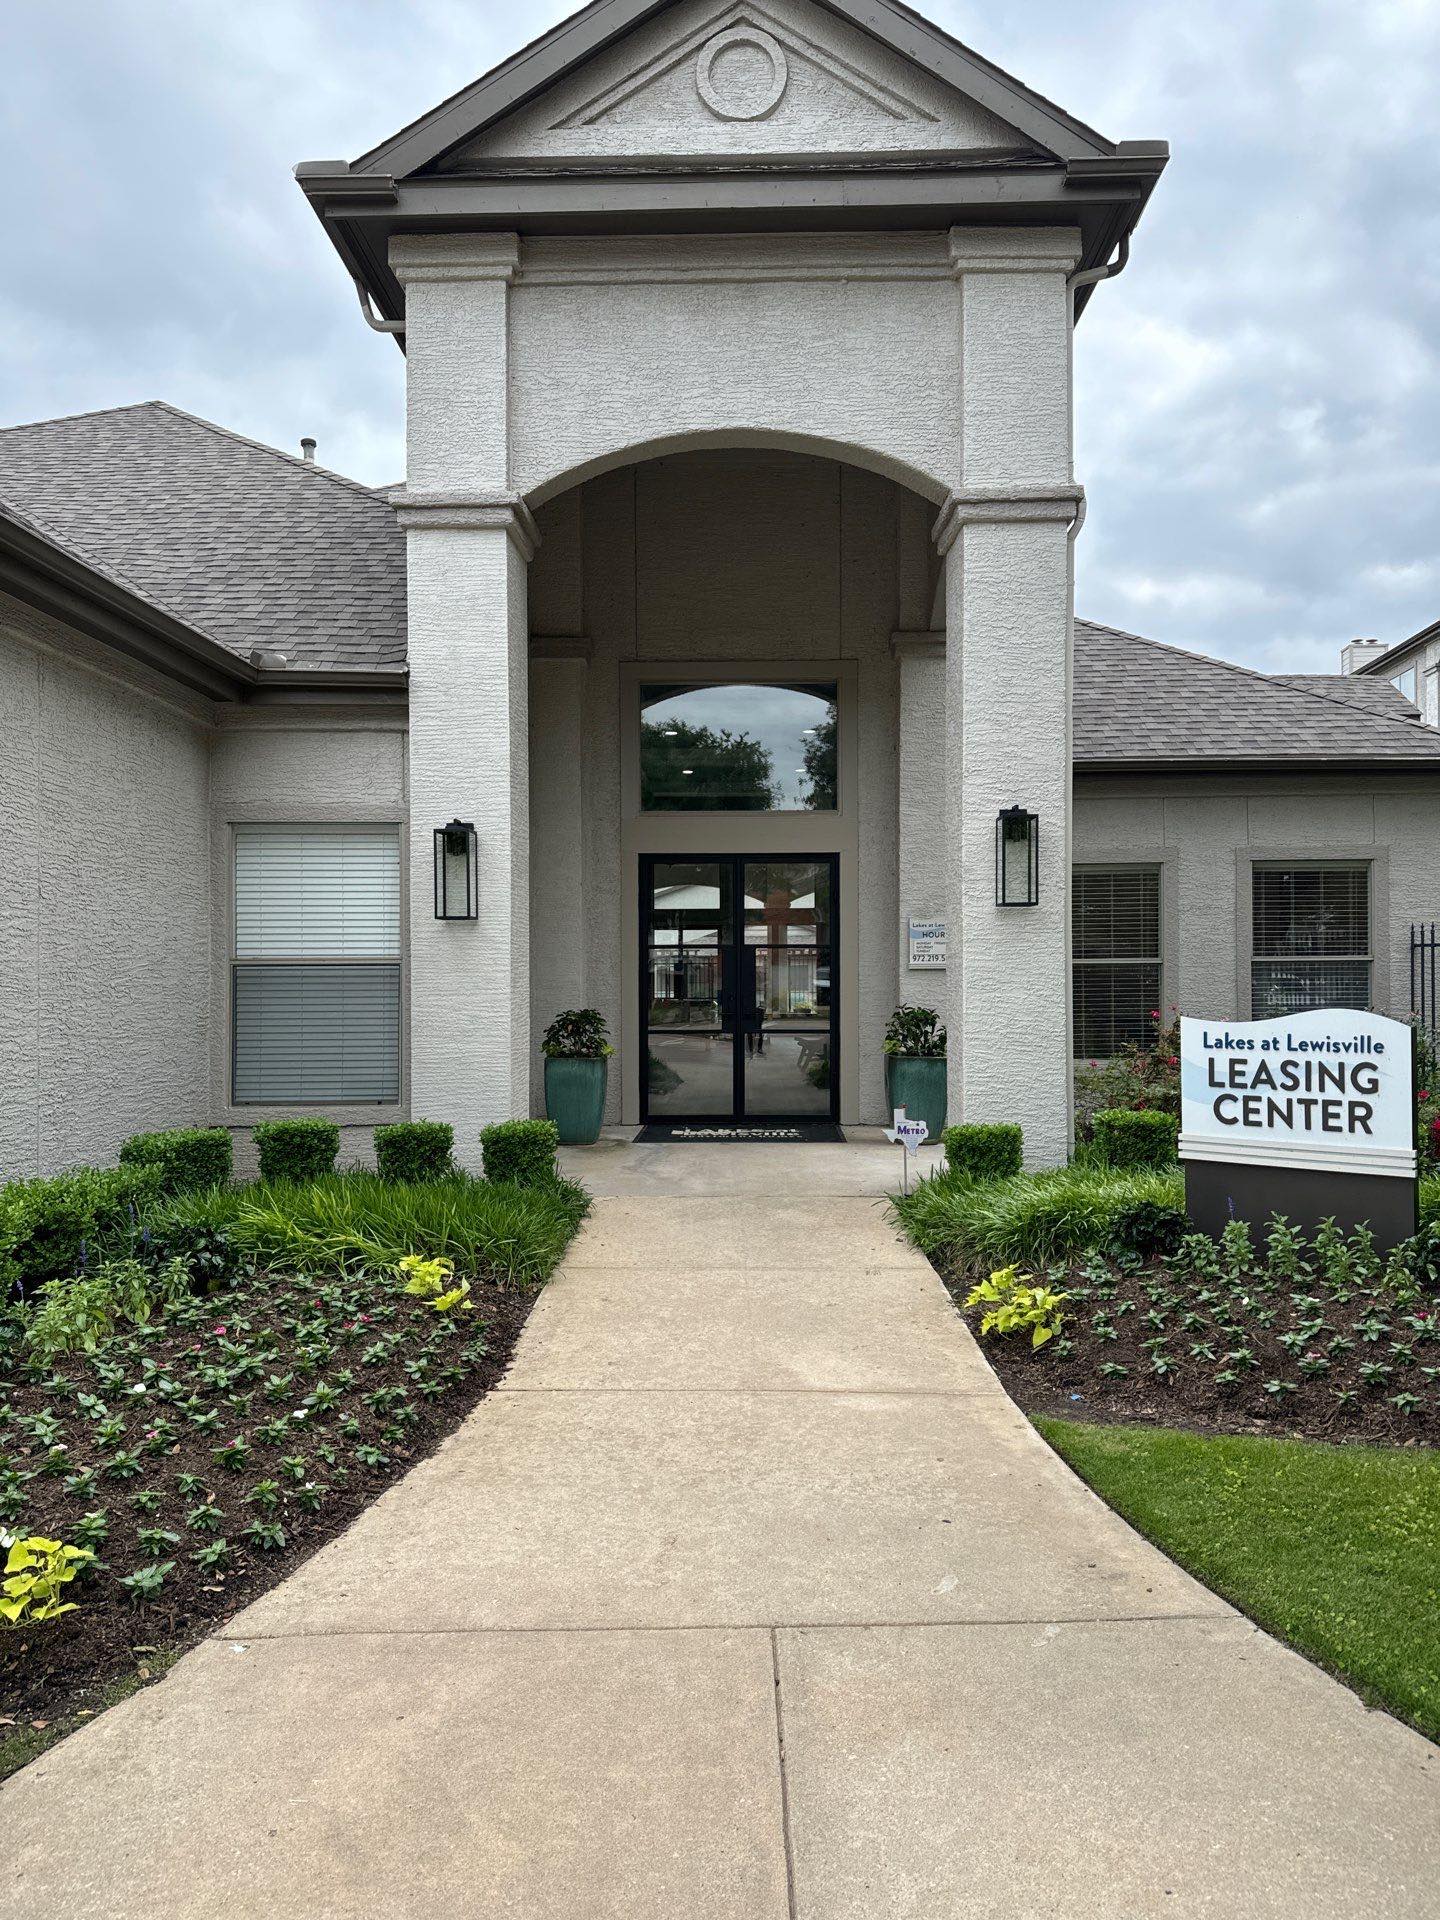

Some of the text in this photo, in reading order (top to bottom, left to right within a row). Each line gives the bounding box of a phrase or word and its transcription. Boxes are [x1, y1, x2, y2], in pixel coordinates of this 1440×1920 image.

[1203, 1031, 1385, 1055] Lakes at Lewisville
[1208, 1057, 1379, 1095] LEASING
[1213, 1093, 1373, 1135] CENTER
